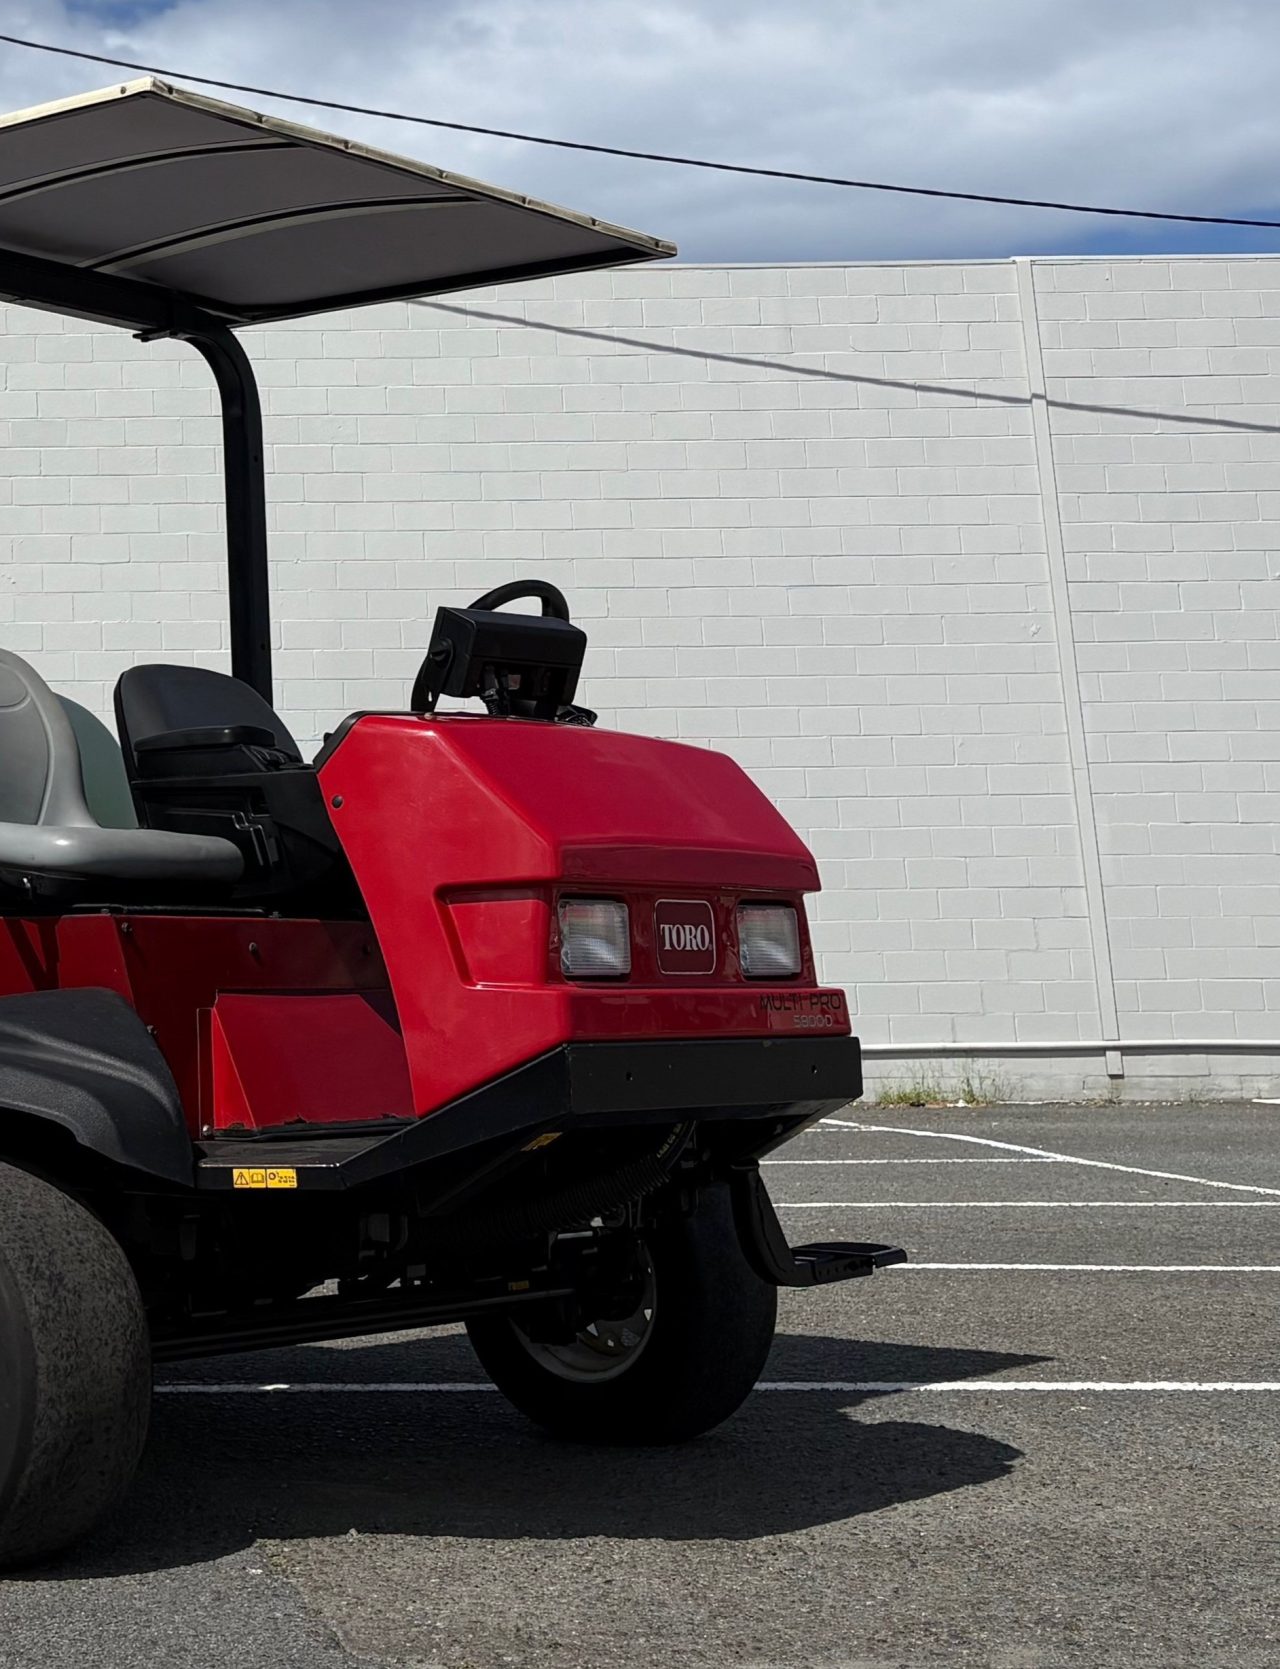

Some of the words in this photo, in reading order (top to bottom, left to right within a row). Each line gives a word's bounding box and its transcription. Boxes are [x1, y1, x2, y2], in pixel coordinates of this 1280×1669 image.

[660, 924, 710, 951] TORO
[760, 993, 804, 1011] MULTI
[810, 993, 842, 1011] PRO
